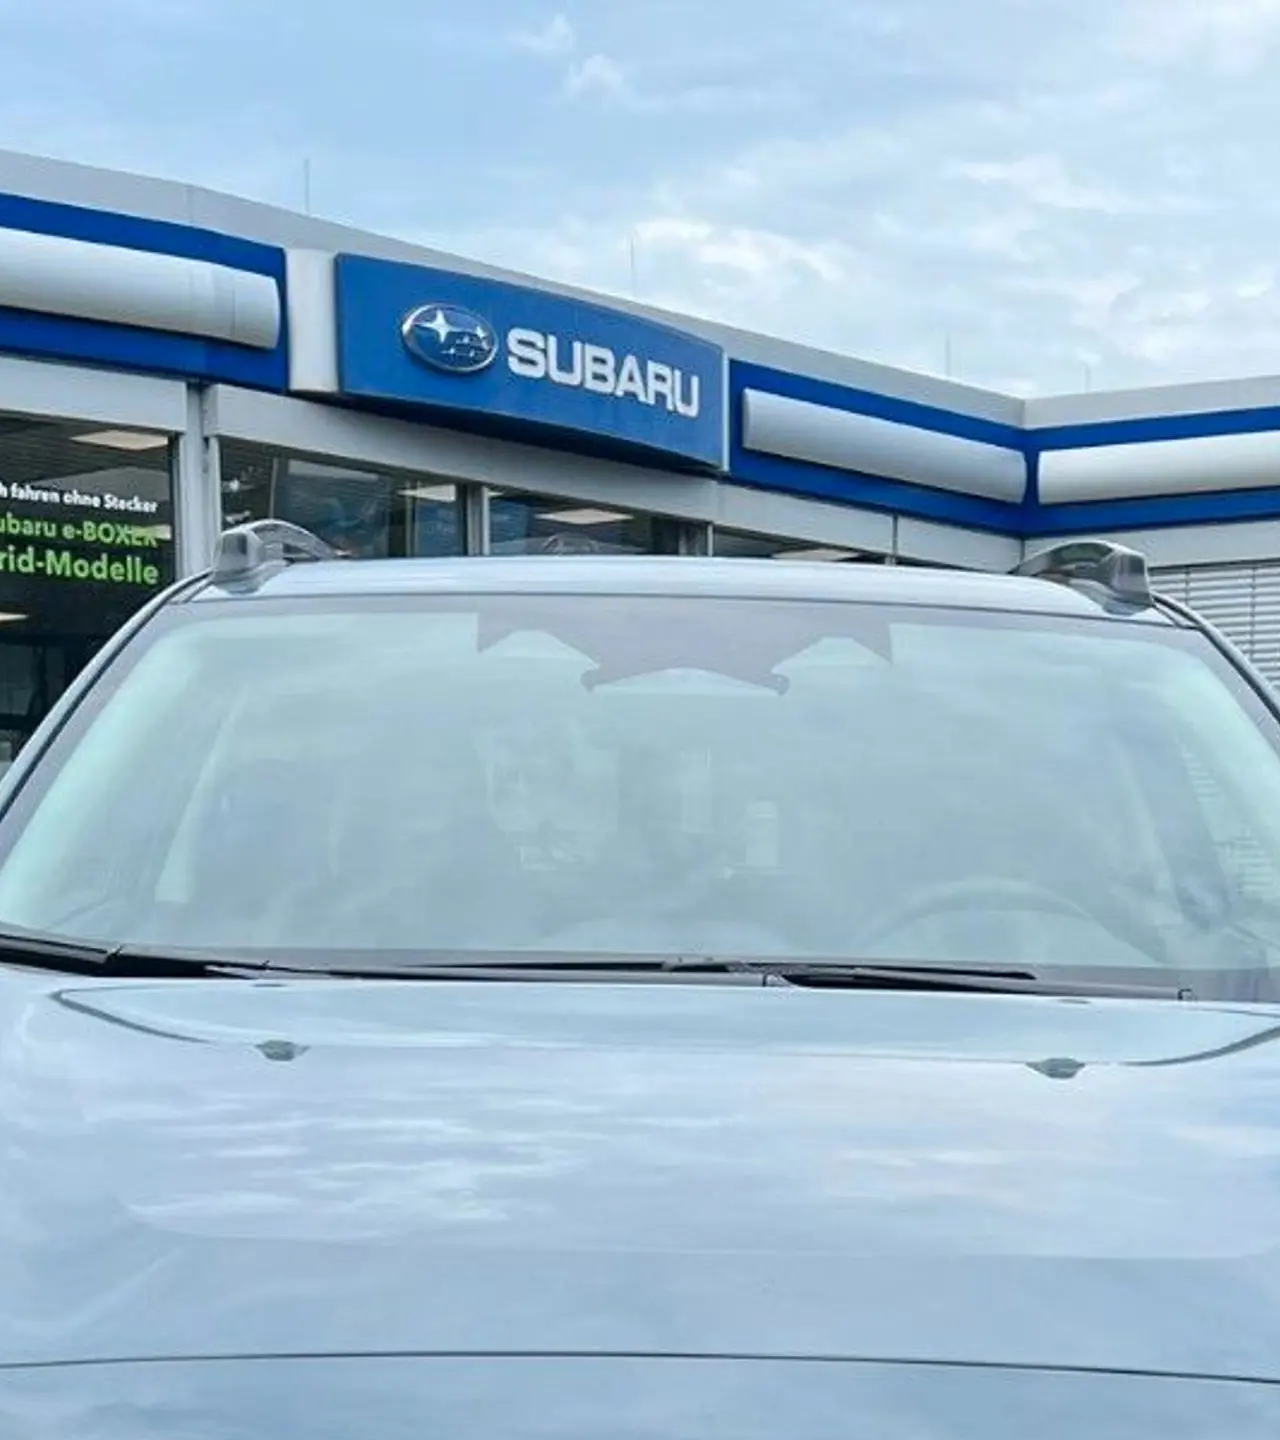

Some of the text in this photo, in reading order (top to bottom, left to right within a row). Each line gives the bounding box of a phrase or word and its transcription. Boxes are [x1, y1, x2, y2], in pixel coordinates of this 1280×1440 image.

[506, 327, 700, 419] SUBARU
[11, 482, 60, 503] fahren
[63, 489, 100, 507] ohne
[103, 493, 158, 513] Stecker
[62, 520, 158, 548] e-BOXER
